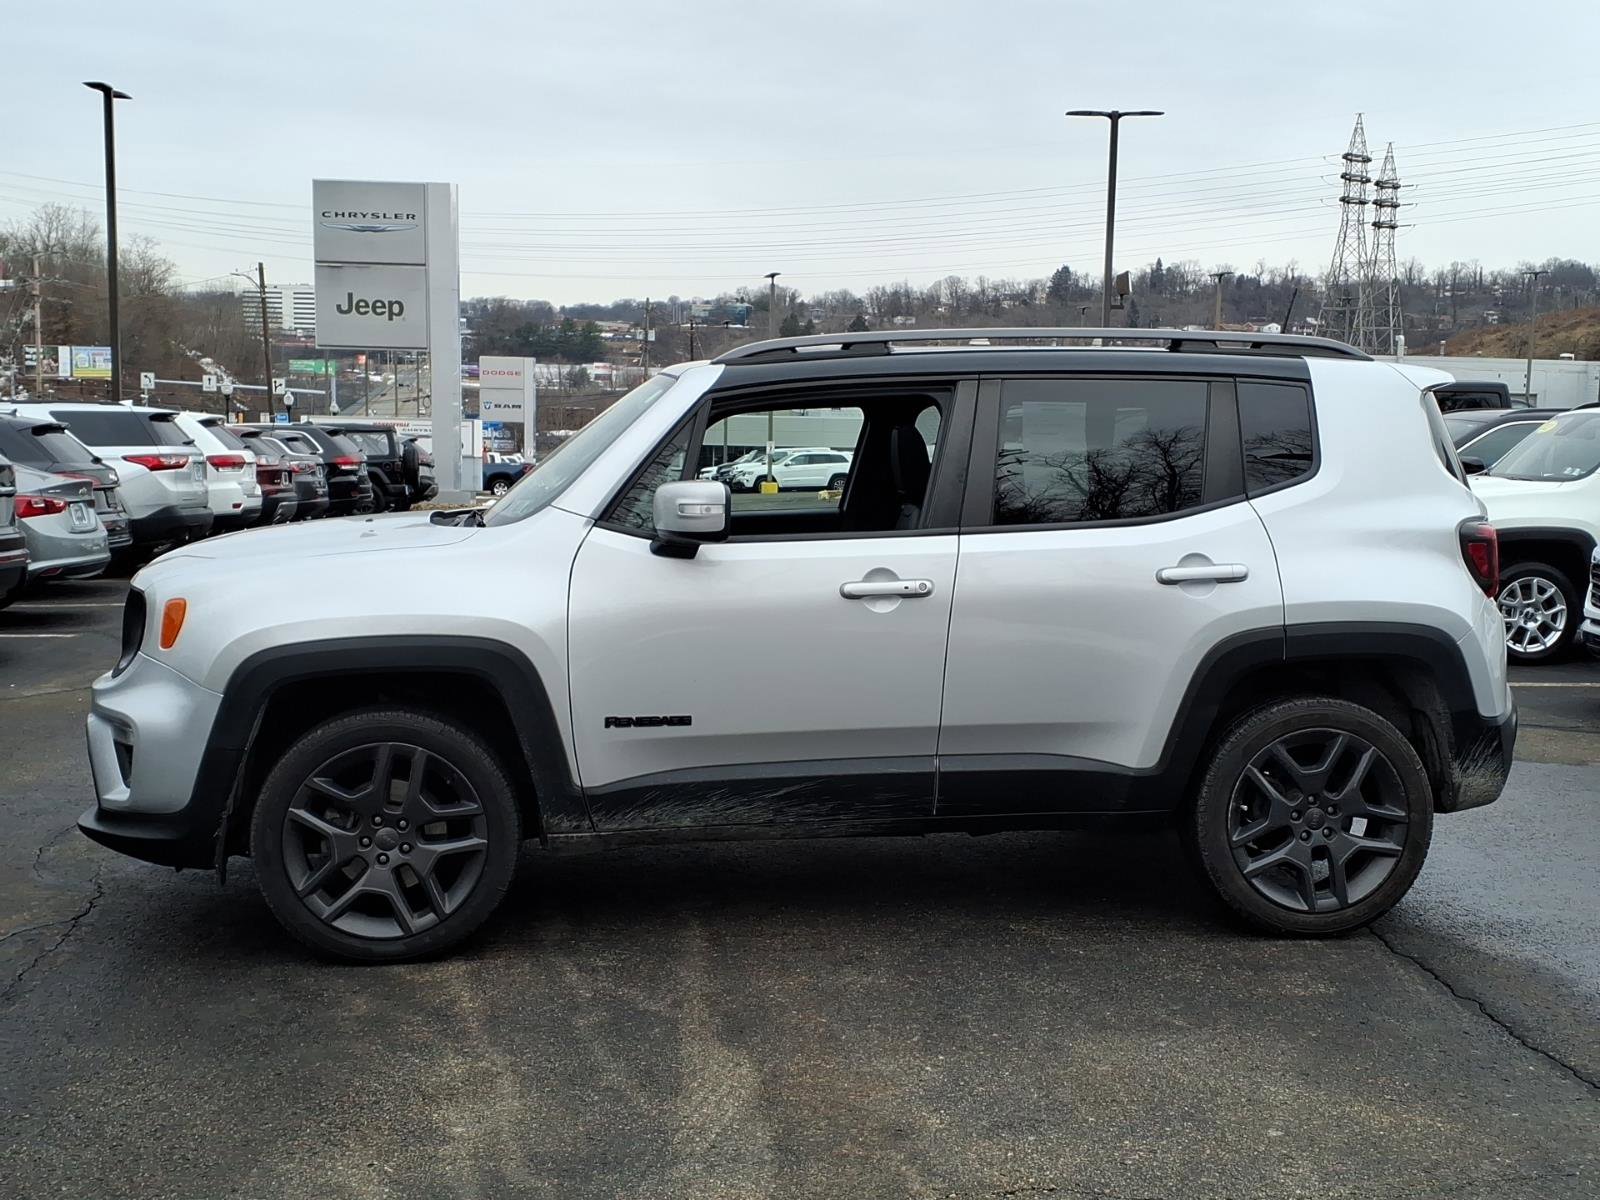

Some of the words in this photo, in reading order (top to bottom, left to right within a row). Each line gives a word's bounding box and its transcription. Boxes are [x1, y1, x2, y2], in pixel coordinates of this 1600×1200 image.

[321, 211, 417, 221] CHRYSLER
[335, 292, 404, 321] Jeep
[604, 715, 692, 729] RENEGADE
